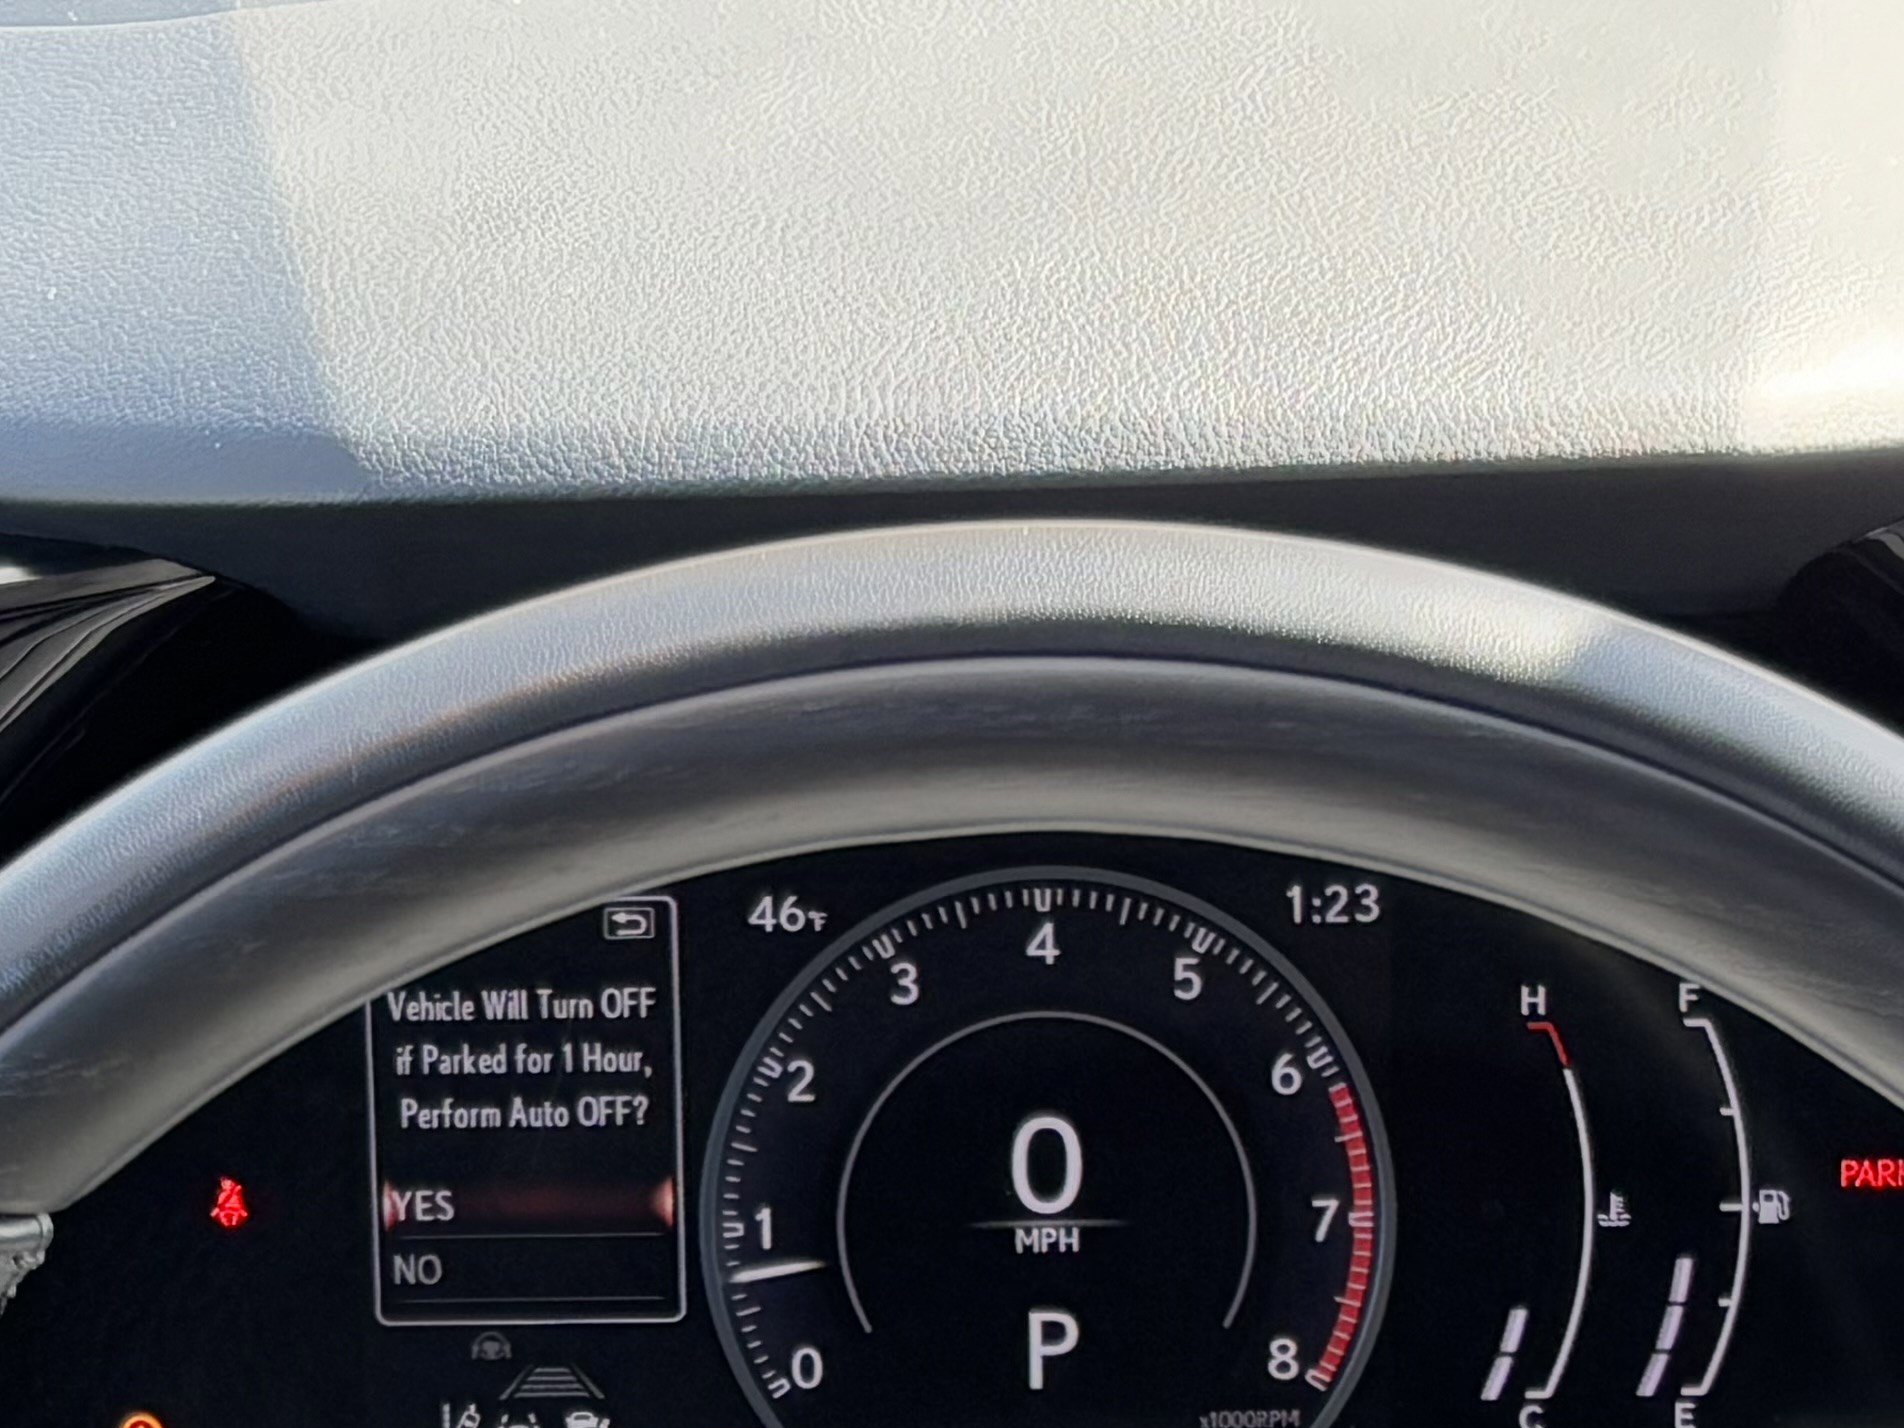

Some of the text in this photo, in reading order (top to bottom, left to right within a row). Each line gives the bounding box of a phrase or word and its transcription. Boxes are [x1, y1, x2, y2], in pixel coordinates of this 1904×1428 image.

[1286, 882, 1380, 924] 1:23
[1025, 921, 1061, 965] 4
[890, 961, 919, 1006] 3
[1172, 958, 1202, 1000] 5
[1520, 984, 1546, 1016] H
[1679, 982, 1700, 1013] F
[387, 986, 656, 1022] Vehicle Will Turn OFF
[396, 1042, 652, 1078] if Parked for 1 Hour,
[786, 1059, 815, 1102] 2
[1271, 1052, 1303, 1095] 6
[400, 1094, 649, 1129] Perform Auto OFF?
[395, 1190, 455, 1222] YES
[1311, 1199, 1340, 1243] 7
[754, 1207, 772, 1250] 1
[1014, 1227, 1080, 1254] MPH
[393, 1253, 443, 1285] NO
[790, 1346, 823, 1390] 0
[1028, 1310, 1080, 1390] P
[1267, 1337, 1300, 1381] 8
